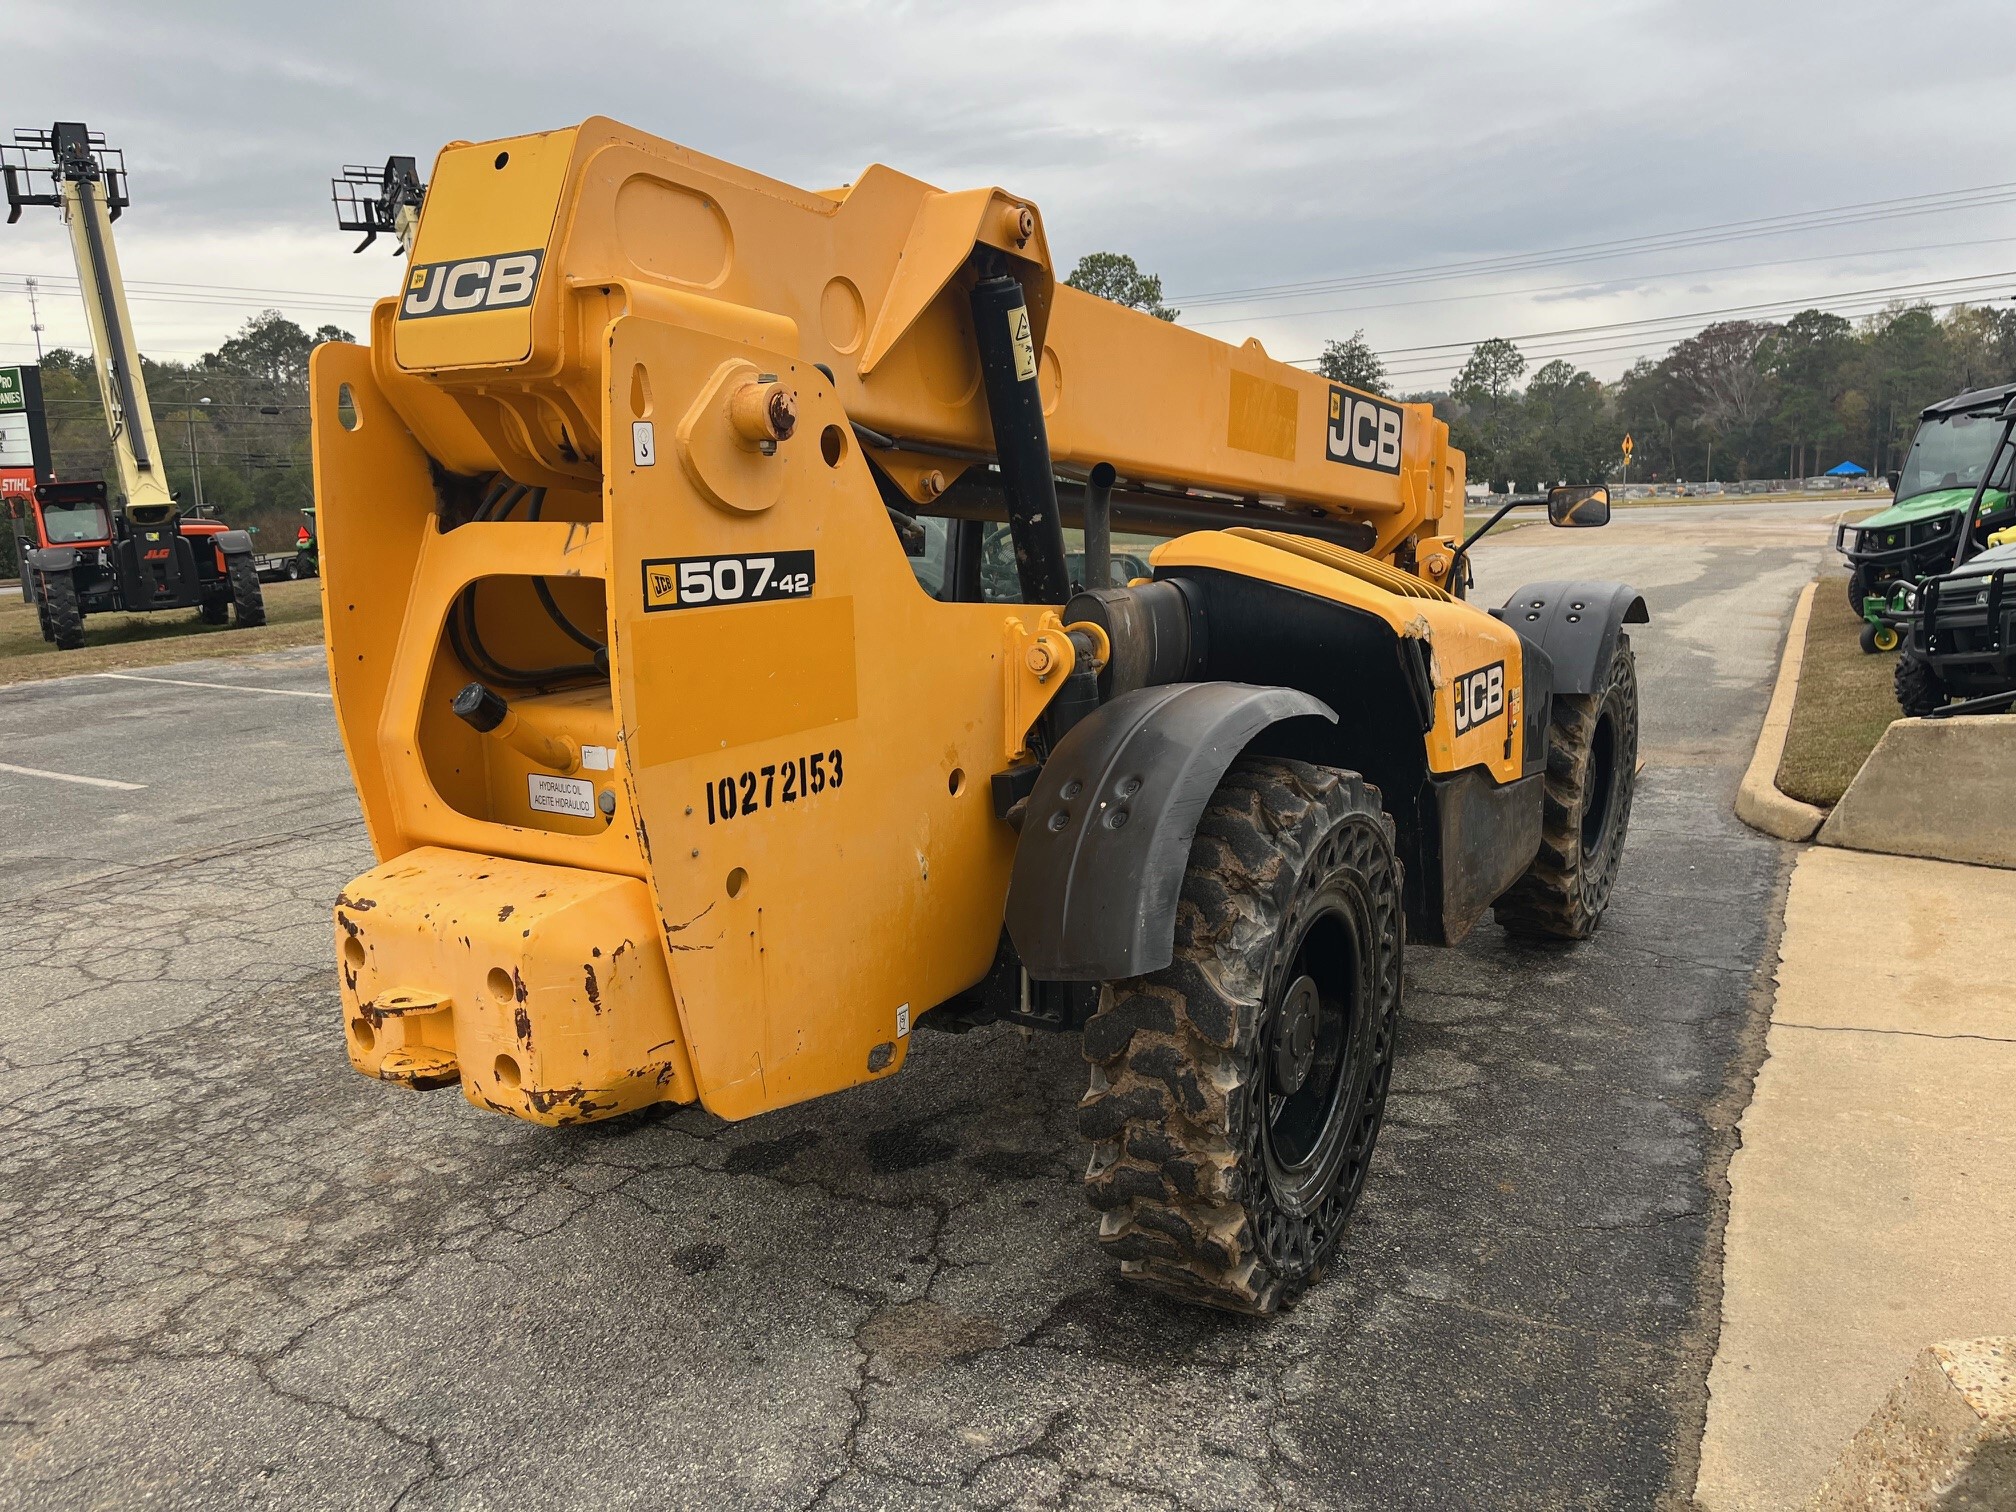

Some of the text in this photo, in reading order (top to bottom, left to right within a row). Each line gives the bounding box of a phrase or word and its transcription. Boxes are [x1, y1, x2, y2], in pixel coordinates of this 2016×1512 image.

[405, 254, 537, 315] JCB
[0, 391, 21, 404] ANIES
[1329, 396, 1401, 468] JCB
[2, 478, 31, 492] STIHL
[143, 548, 170, 559] JLG
[654, 557, 809, 603] JCB 507-42
[1455, 666, 1503, 730] JCB
[534, 795, 554, 807] ACEITE
[539, 780, 582, 796] HYDRAULIC OIL
[706, 749, 844, 825] 10272153
